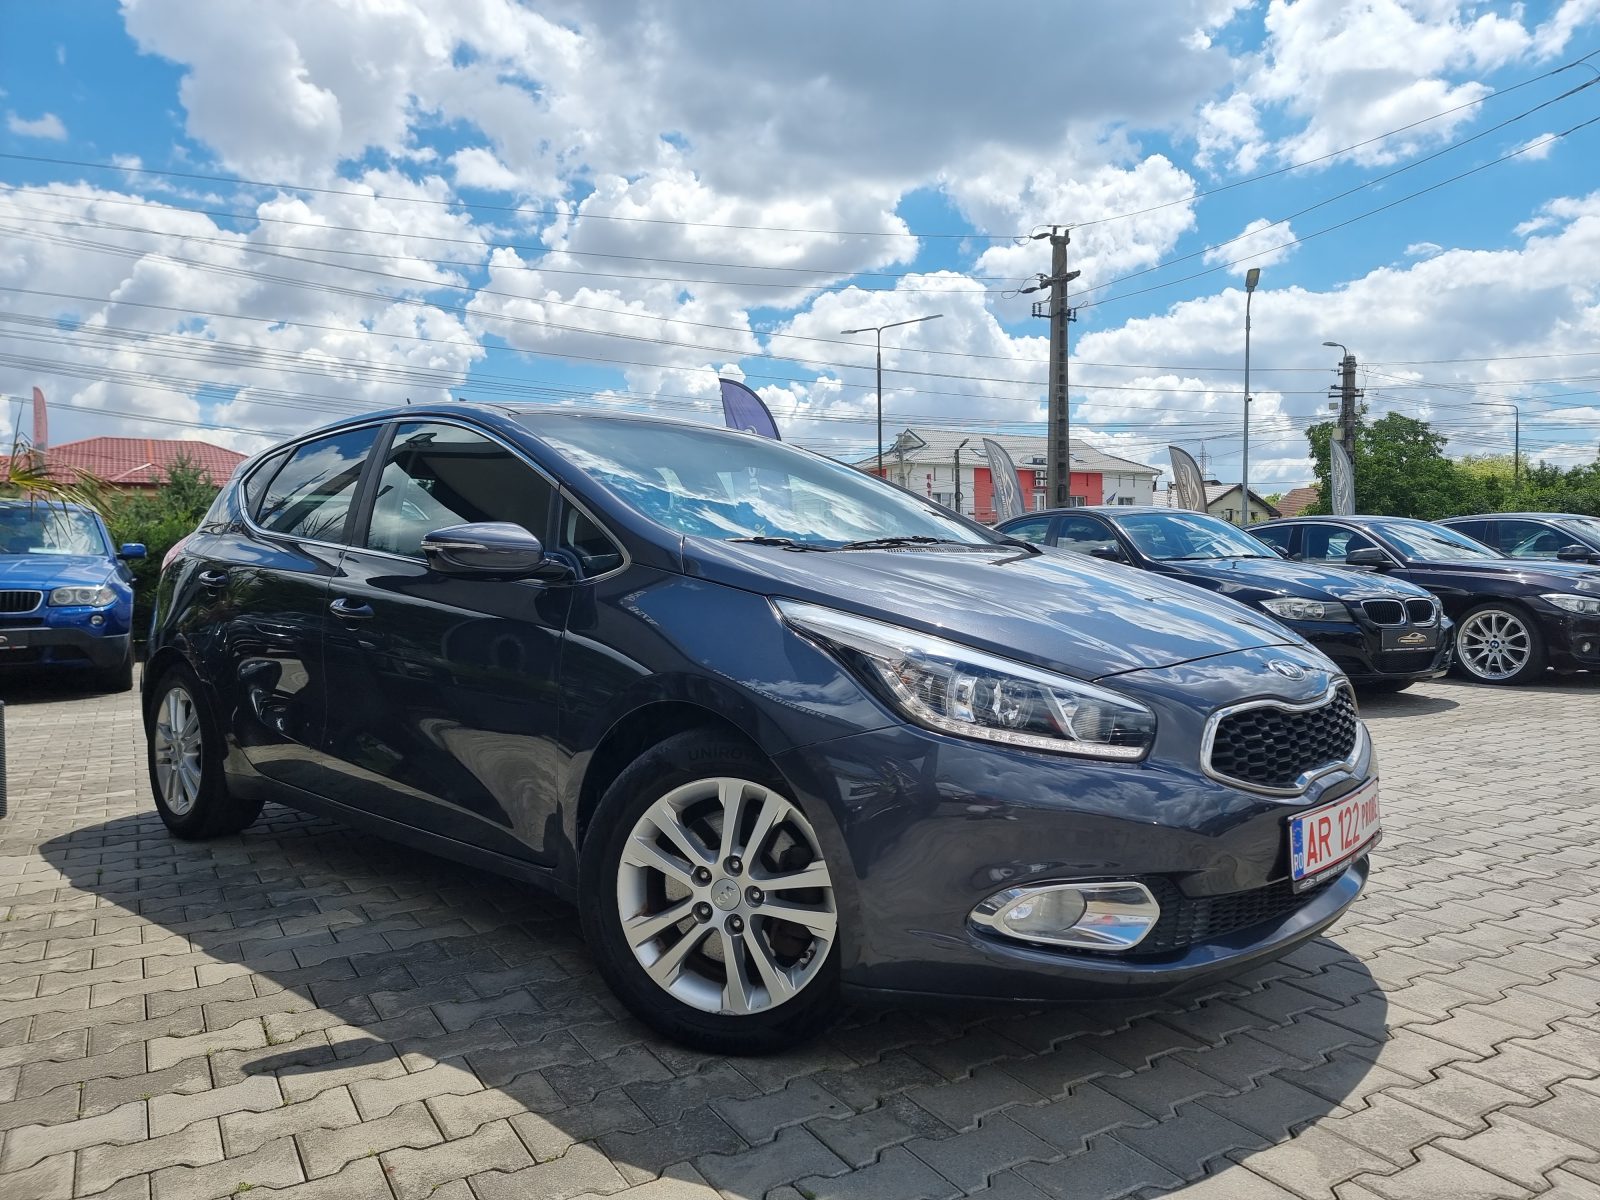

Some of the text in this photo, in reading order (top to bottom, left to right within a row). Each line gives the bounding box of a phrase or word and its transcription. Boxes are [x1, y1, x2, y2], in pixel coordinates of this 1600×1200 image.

[1294, 852, 1304, 872] RO
[1307, 816, 1332, 867] AR
[1338, 801, 1360, 851] 122
[715, 885, 736, 907] KIA
